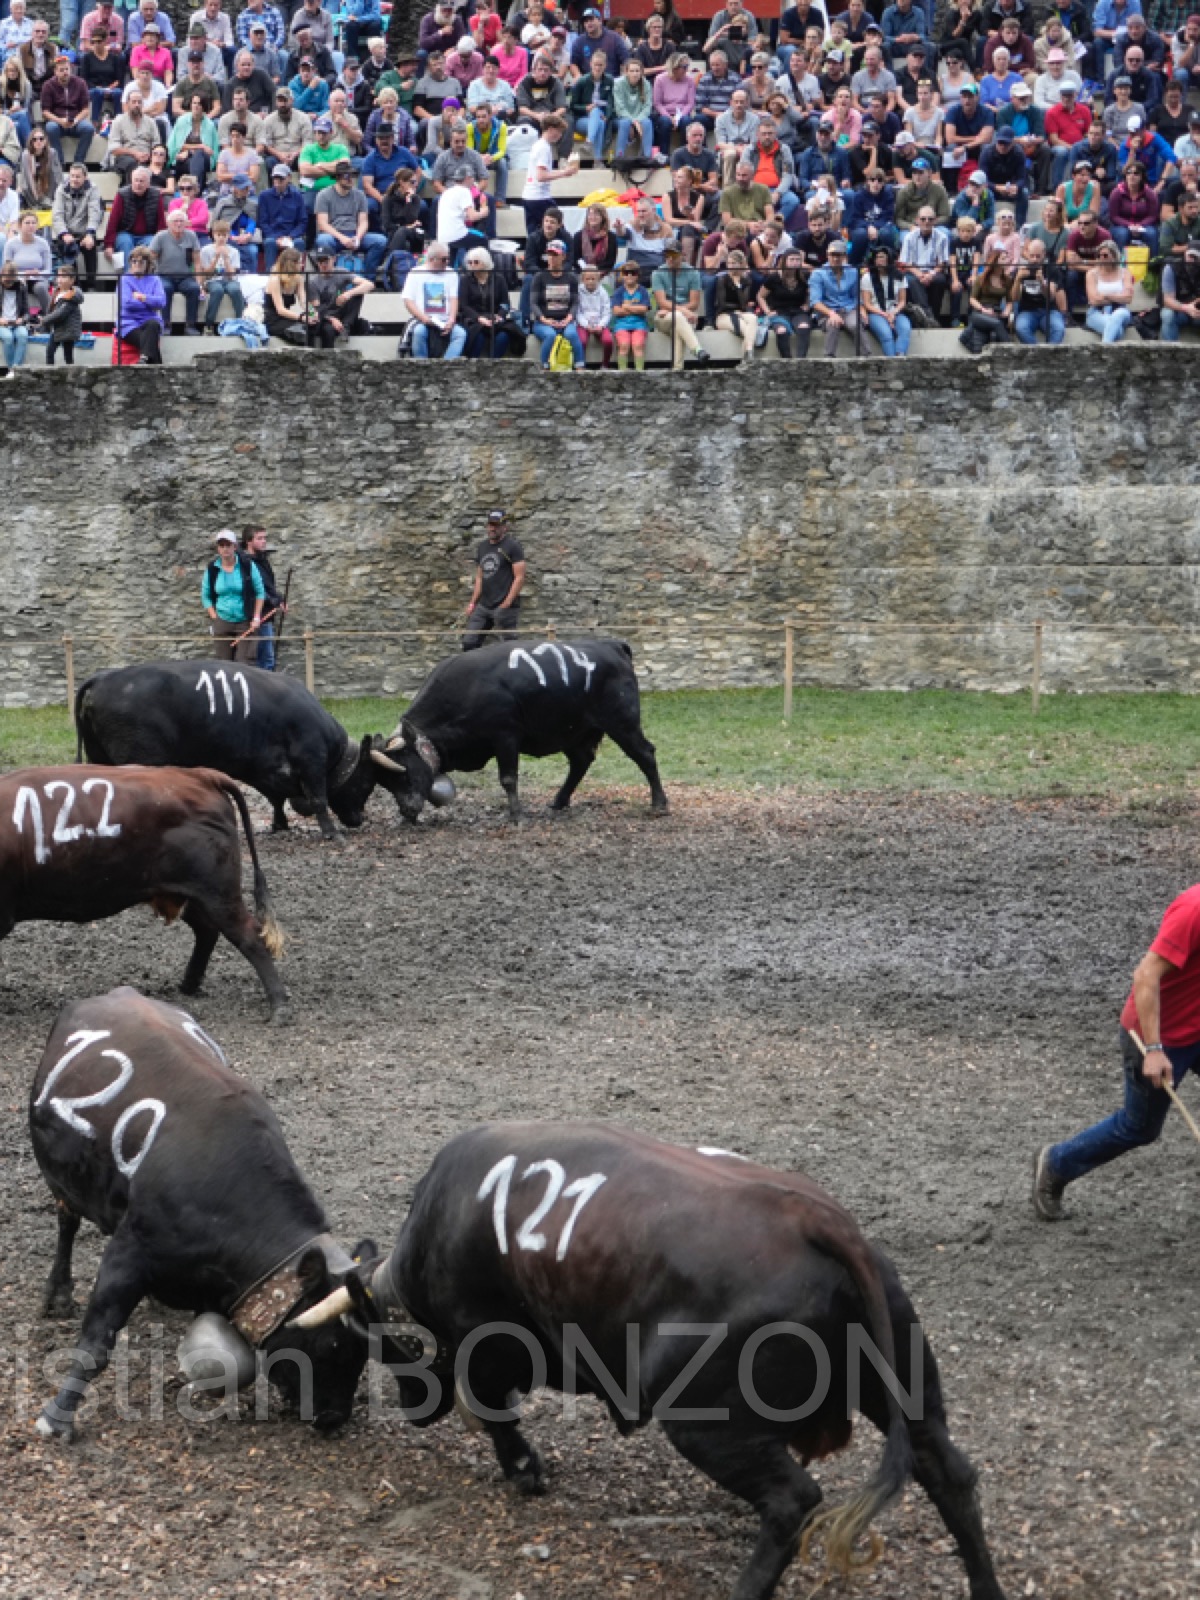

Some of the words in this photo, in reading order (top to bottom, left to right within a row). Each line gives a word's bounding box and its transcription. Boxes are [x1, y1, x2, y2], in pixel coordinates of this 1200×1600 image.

[195, 669, 251, 718] 111
[507, 642, 597, 692] 114
[12, 778, 121, 864] 122
[33, 1028, 167, 1179] 120
[477, 1154, 608, 1262] 121
